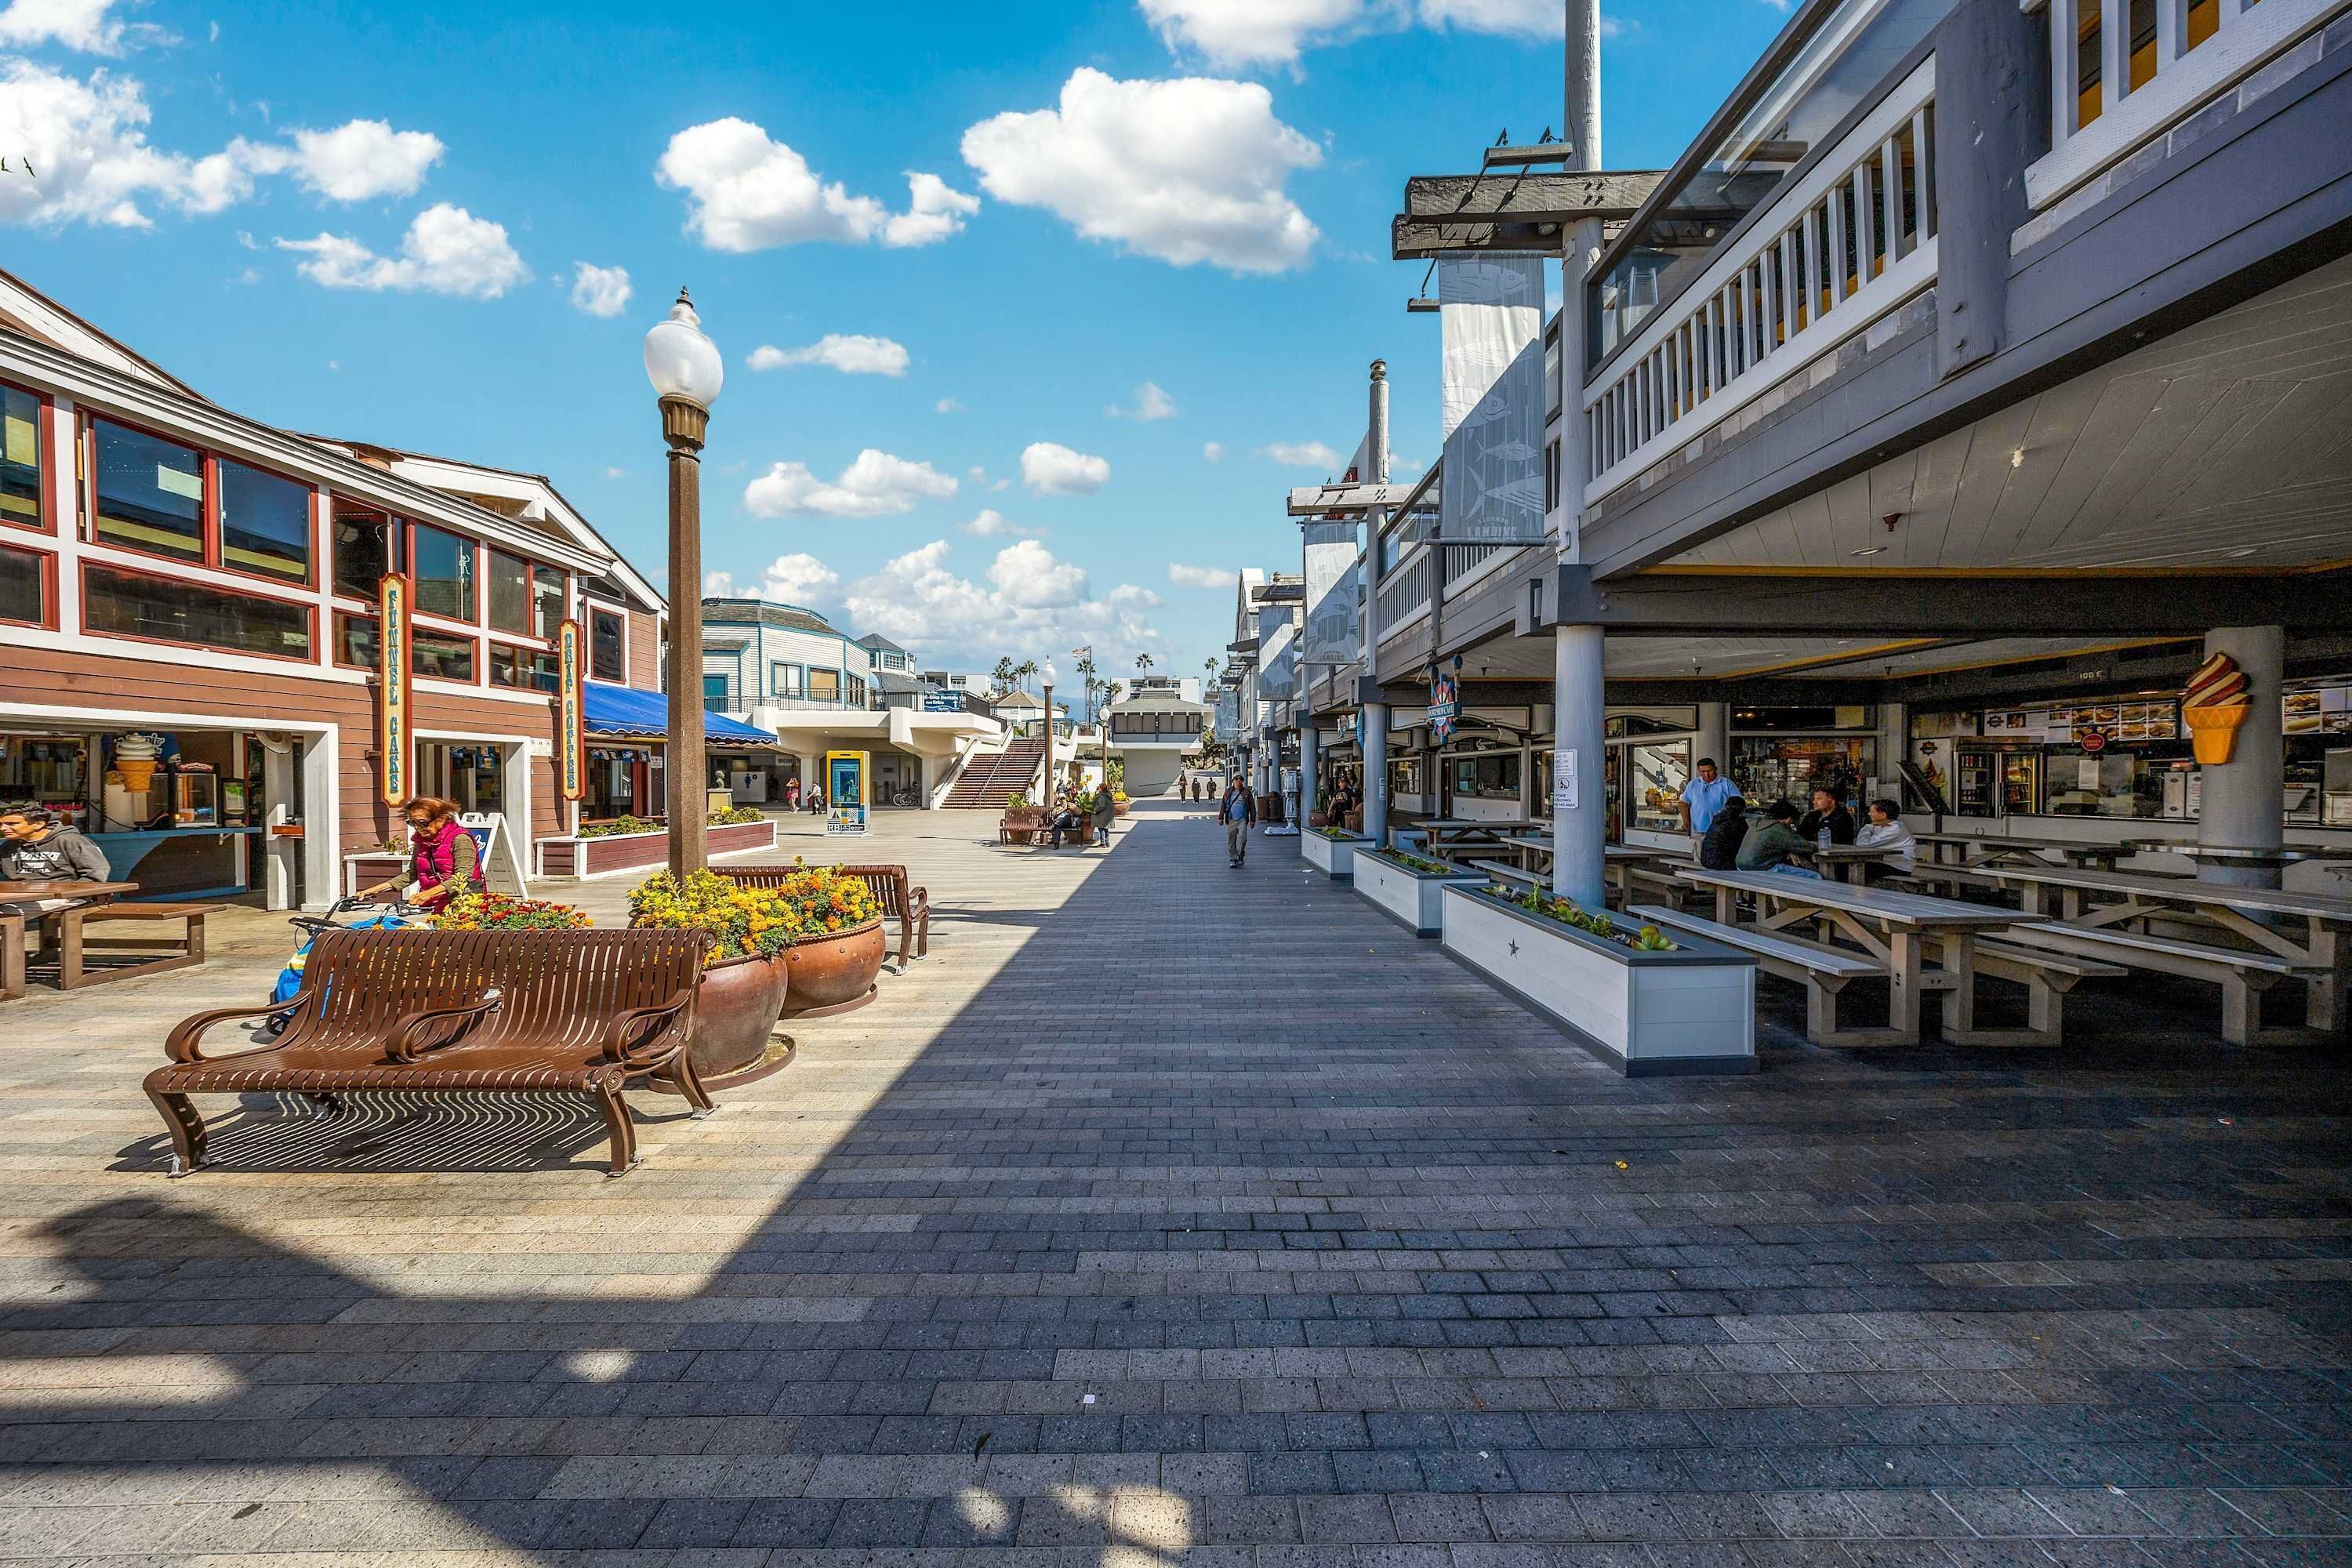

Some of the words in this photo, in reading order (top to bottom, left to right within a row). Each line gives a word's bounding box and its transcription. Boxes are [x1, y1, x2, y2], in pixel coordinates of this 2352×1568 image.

[388, 590, 399, 706] FUNNEL
[564, 633, 574, 693] DRIP
[389, 716, 400, 793] CAKE
[565, 699, 575, 789] COFFEE
